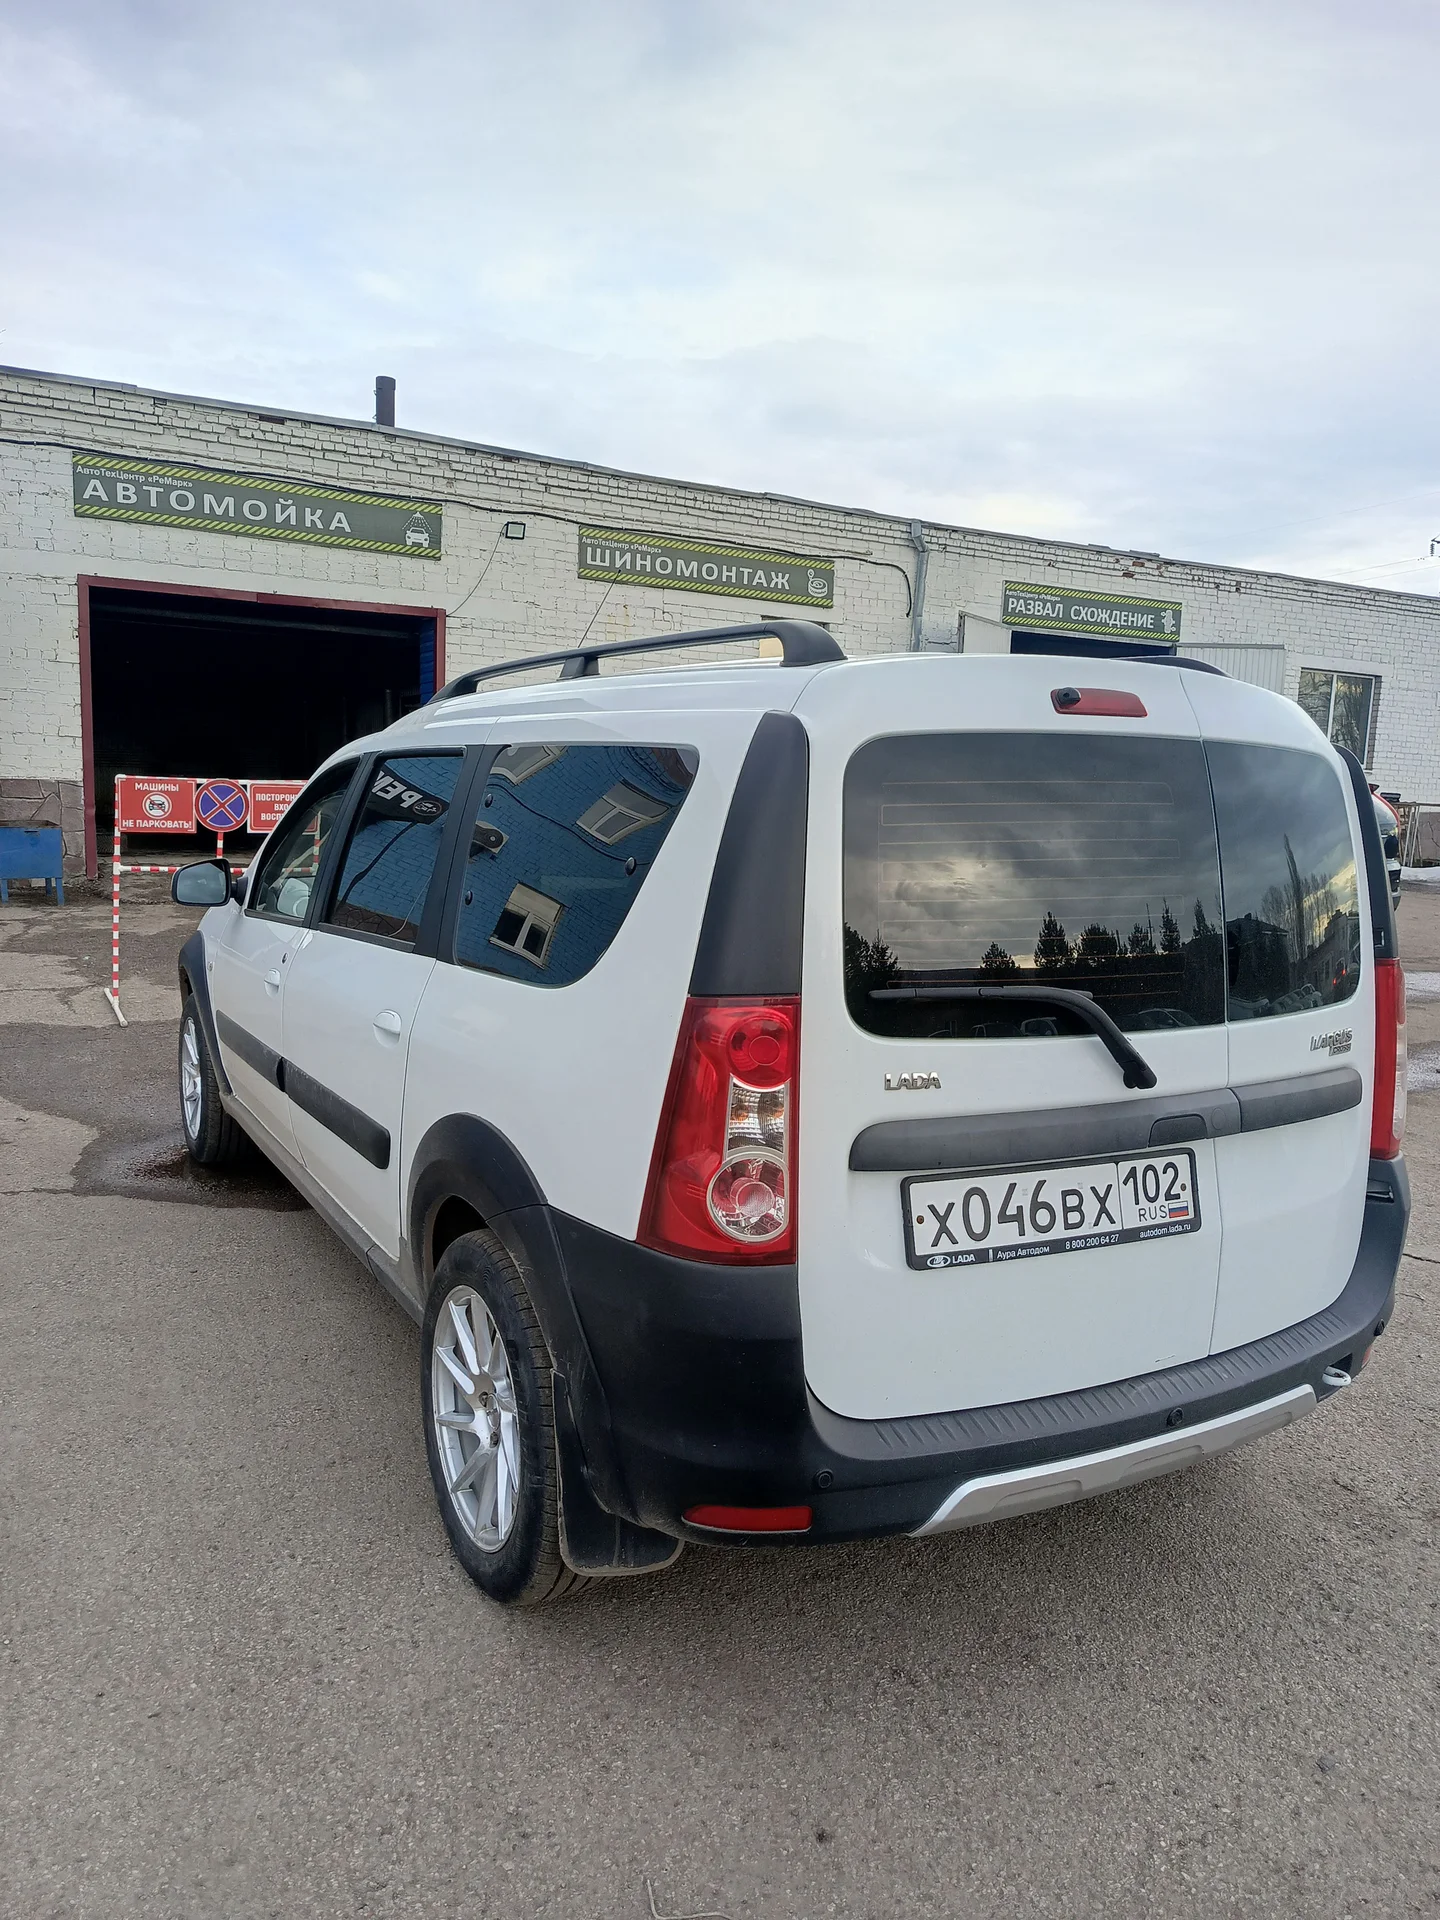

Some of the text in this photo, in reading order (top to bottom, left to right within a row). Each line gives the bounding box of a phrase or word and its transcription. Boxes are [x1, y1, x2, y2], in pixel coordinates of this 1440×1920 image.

[76, 465, 193, 488] АвтоТехЦентр «РеМарк»
[82, 478, 352, 533] АВТОМОЙКА
[581, 536, 629, 550] АвтоТехЦентр
[586, 546, 790, 590] ШИНОМОНТАЖ
[1007, 597, 1155, 629] РАЗВАЛ СХОЖДЕНИЕ
[134, 782, 179, 792] МАШИНЫ
[255, 793, 298, 802] ПОСТОРОН
[122, 819, 192, 829] НЕ ПАРКОВАТЬ!
[884, 1071, 942, 1091] LADA
[927, 1161, 1181, 1247] Х046ВХ 102
[1138, 1204, 1167, 1222] RUS
[1140, 1223, 1191, 1239] autodom.lada.ru
[1065, 1233, 1119, 1250] 8 800 200 64 27
[952, 1253, 976, 1264] LADA
[997, 1246, 1050, 1260] Аура Автодом
